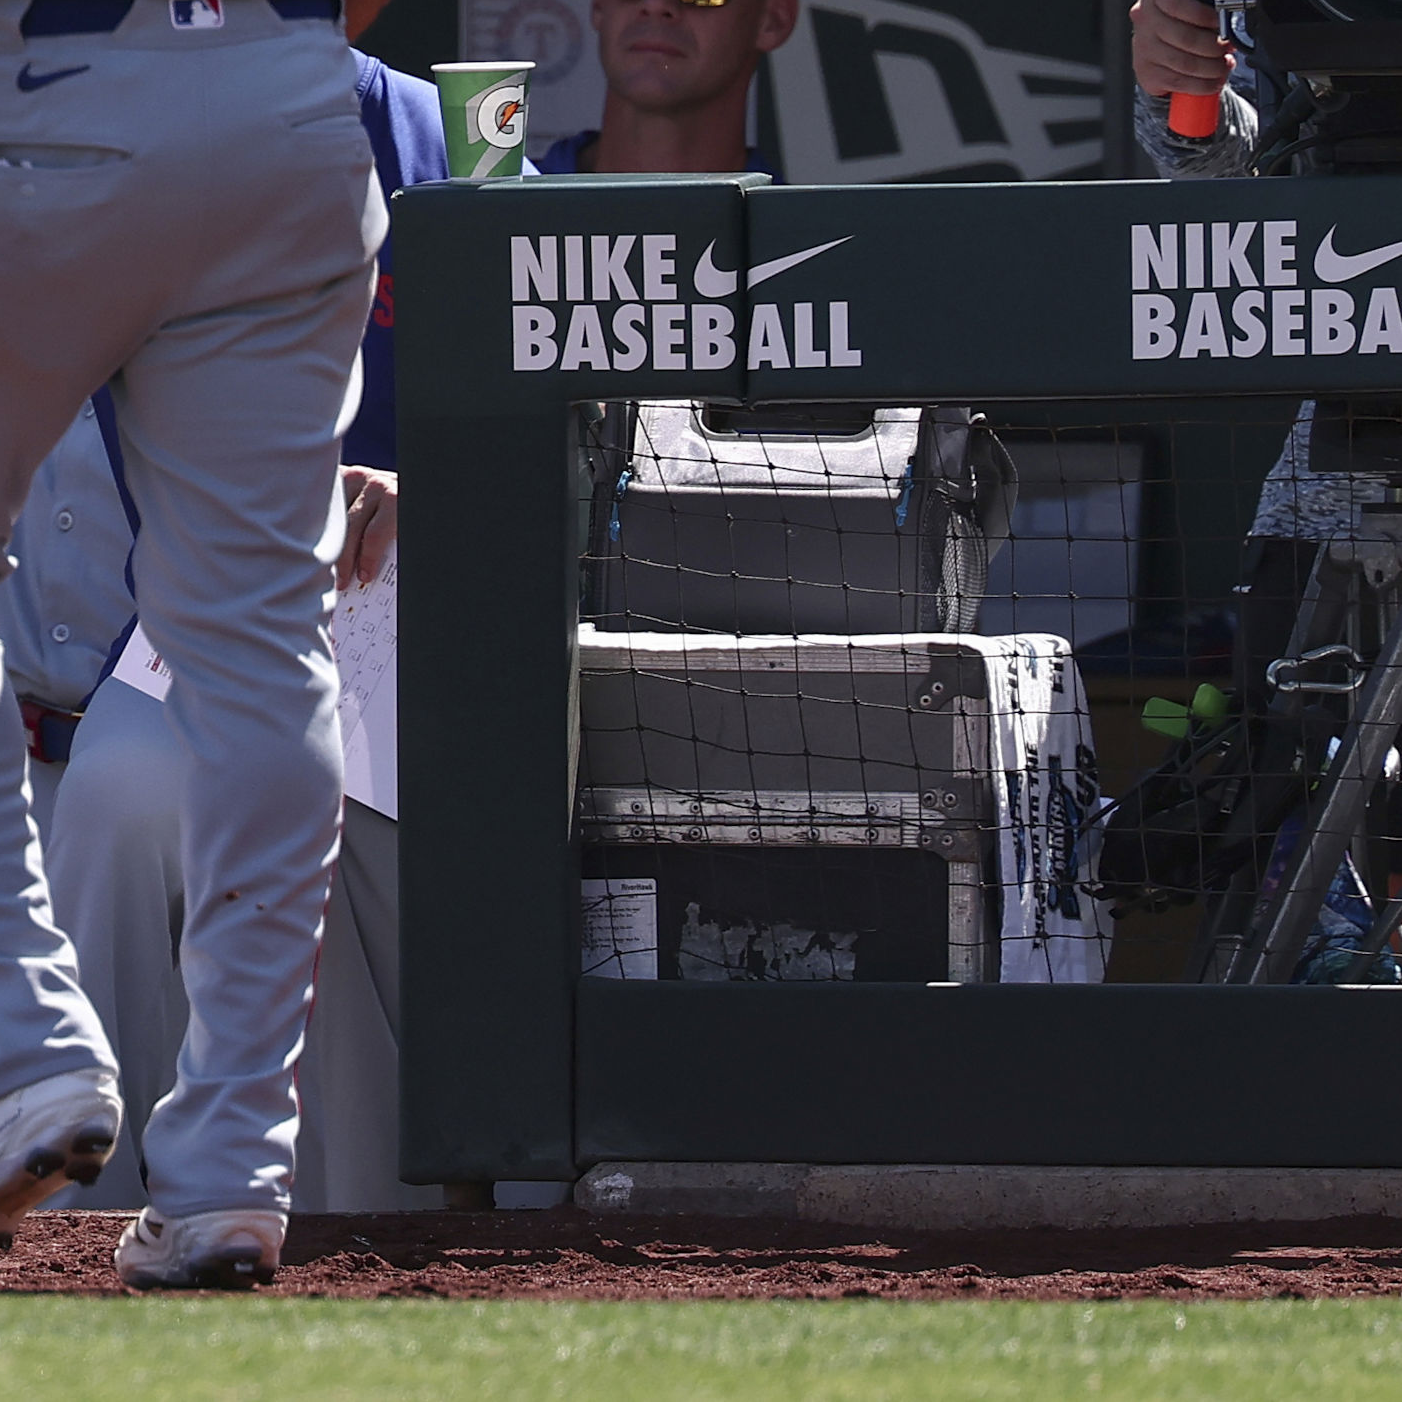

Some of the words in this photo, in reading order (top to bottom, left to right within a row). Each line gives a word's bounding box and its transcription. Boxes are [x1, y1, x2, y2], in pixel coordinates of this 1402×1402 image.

[477, 84, 527, 149] G
[510, 234, 678, 302] NIKE
[1131, 220, 1297, 290] NIKE
[512, 302, 863, 372] BASEBALL
[1132, 288, 1402, 360] BASEBA
